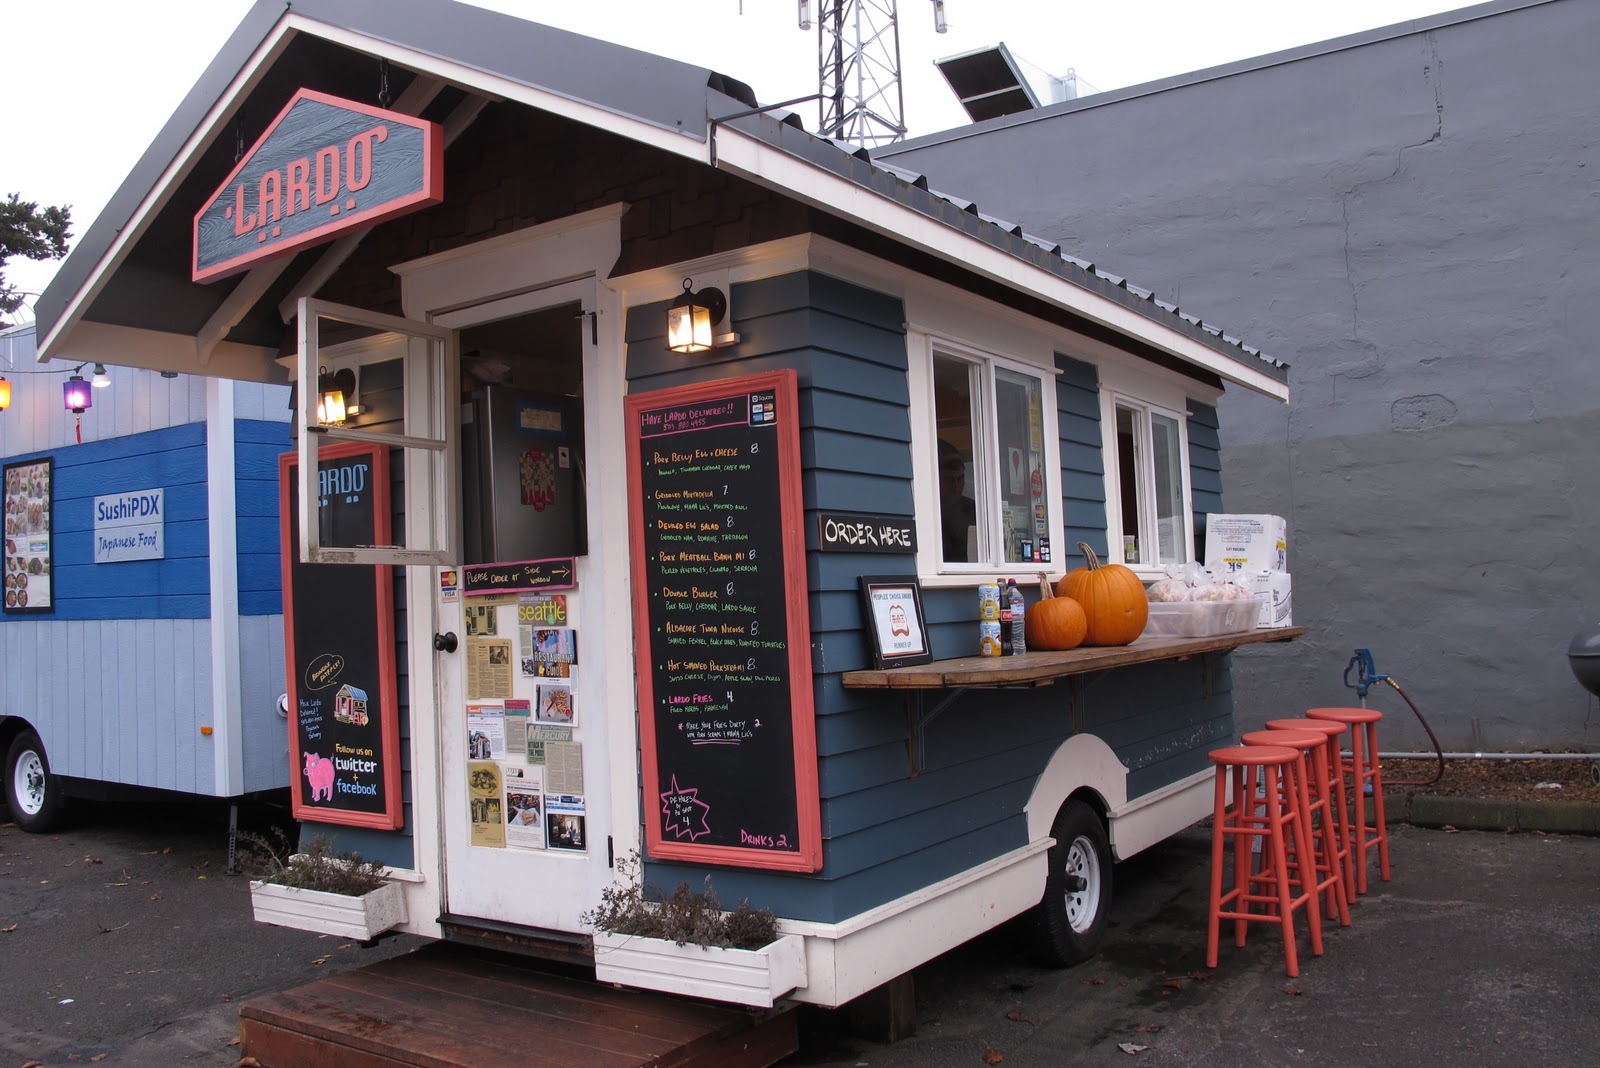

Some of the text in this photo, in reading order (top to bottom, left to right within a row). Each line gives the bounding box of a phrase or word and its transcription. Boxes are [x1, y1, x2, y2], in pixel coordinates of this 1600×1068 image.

[233, 125, 388, 237] LARDO
[641, 412, 662, 427] HAVE
[664, 410, 688, 423] LARDO
[654, 452, 670, 464] PORK
[672, 452, 694, 464] BELLY
[318, 464, 368, 496] ARDO
[98, 495, 159, 521] SushiPDX
[825, 519, 911, 546] ORDER HERE
[98, 531, 157, 559] Japanese Food
[659, 551, 676, 561] PORK
[680, 552, 711, 561] MEATBALL
[466, 566, 540, 585] PLEASE ORDER AT SIDE
[530, 576, 551, 585] WINDOW
[663, 587, 688, 598] DOUBLE
[692, 586, 718, 599] BURGER
[518, 601, 566, 621] seattle
[666, 621, 696, 634] ALBACORE
[700, 624, 718, 633] TUNA
[535, 652, 572, 664] RESTAURANT
[668, 660, 680, 670] HOT
[546, 667, 563, 676] GUIDE
[668, 696, 691, 704] LARDO
[693, 694, 713, 704] FRIES
[528, 725, 570, 741] MERCURY
[335, 743, 355, 755] Follow
[335, 757, 377, 773] twitter
[741, 829, 774, 847] DRINKS
